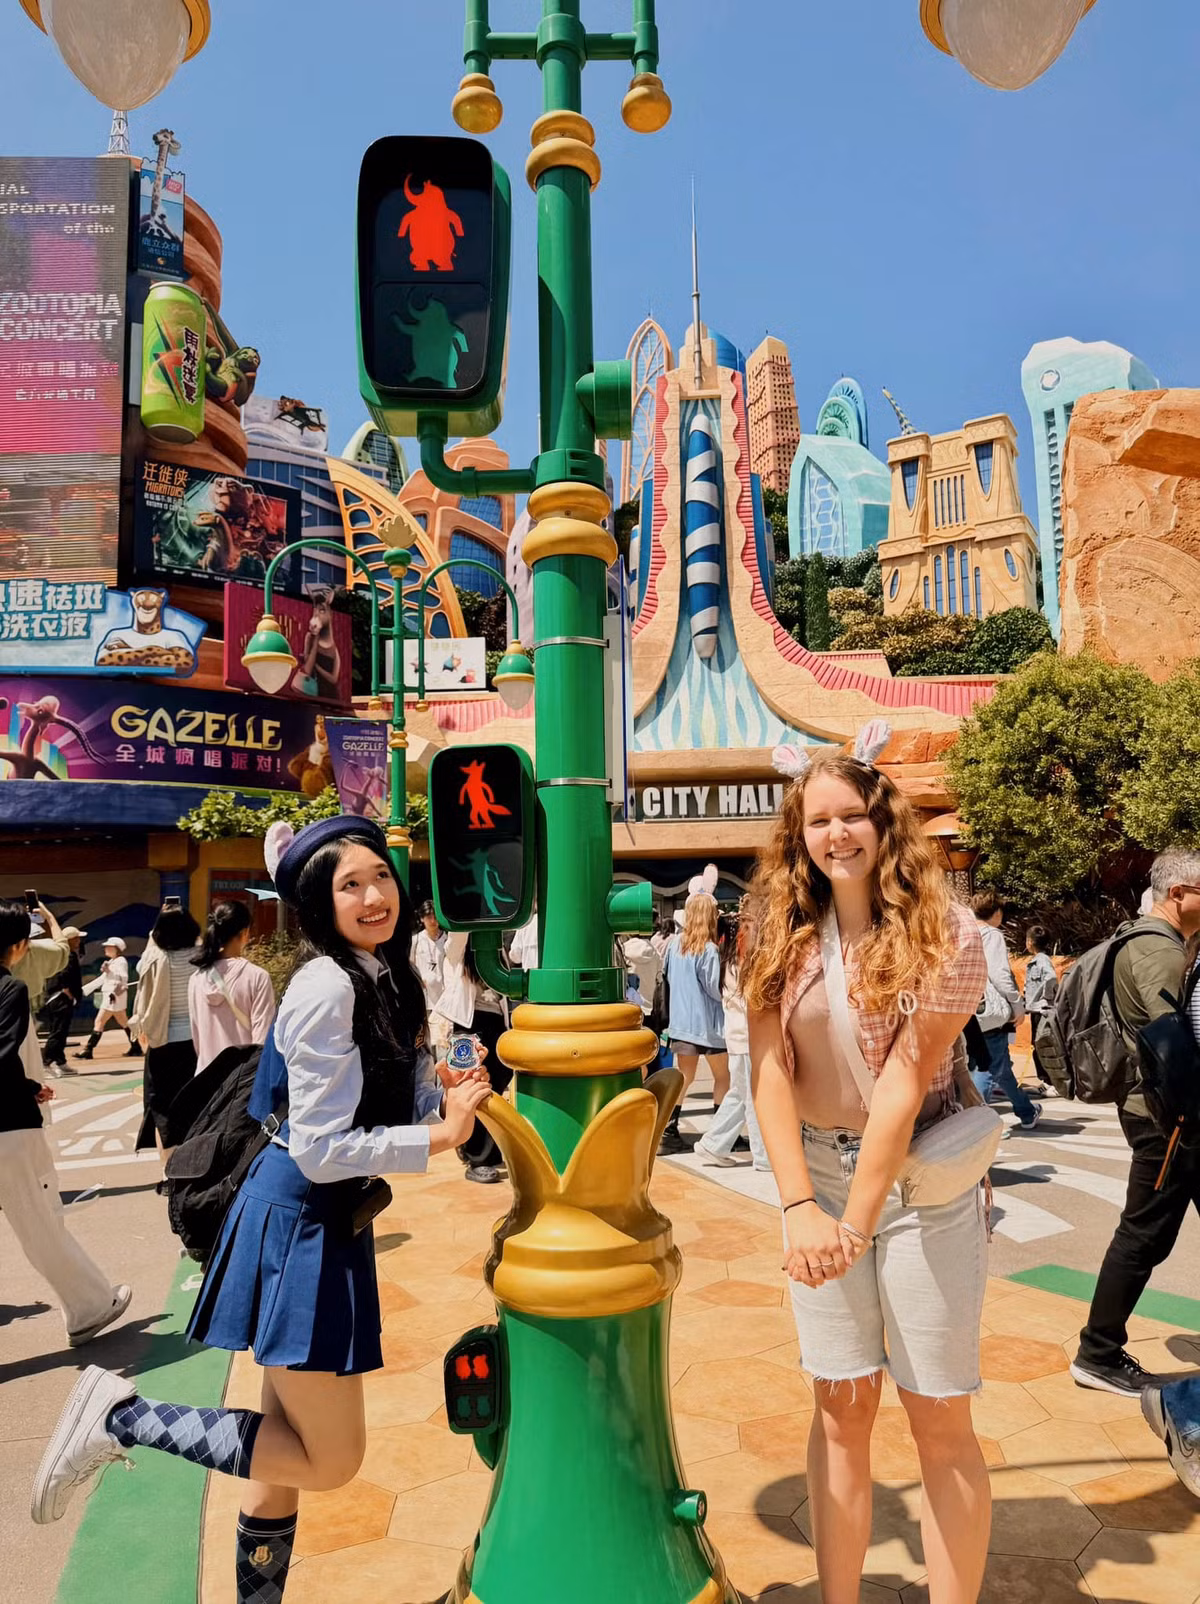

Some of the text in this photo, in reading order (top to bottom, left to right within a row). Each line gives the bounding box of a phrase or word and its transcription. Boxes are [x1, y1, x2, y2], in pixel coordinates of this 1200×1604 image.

[0, 292, 122, 316] ZOOTOPIA
[0, 318, 118, 341] CONCERT
[0, 580, 103, 612] 速祛斑
[0, 612, 89, 638] 洗衣液
[111, 705, 283, 751] GAZELLE
[115, 743, 281, 773] 全城疯唱派对!
[342, 741, 385, 752] GAZELLE
[642, 786, 710, 817] CITY
